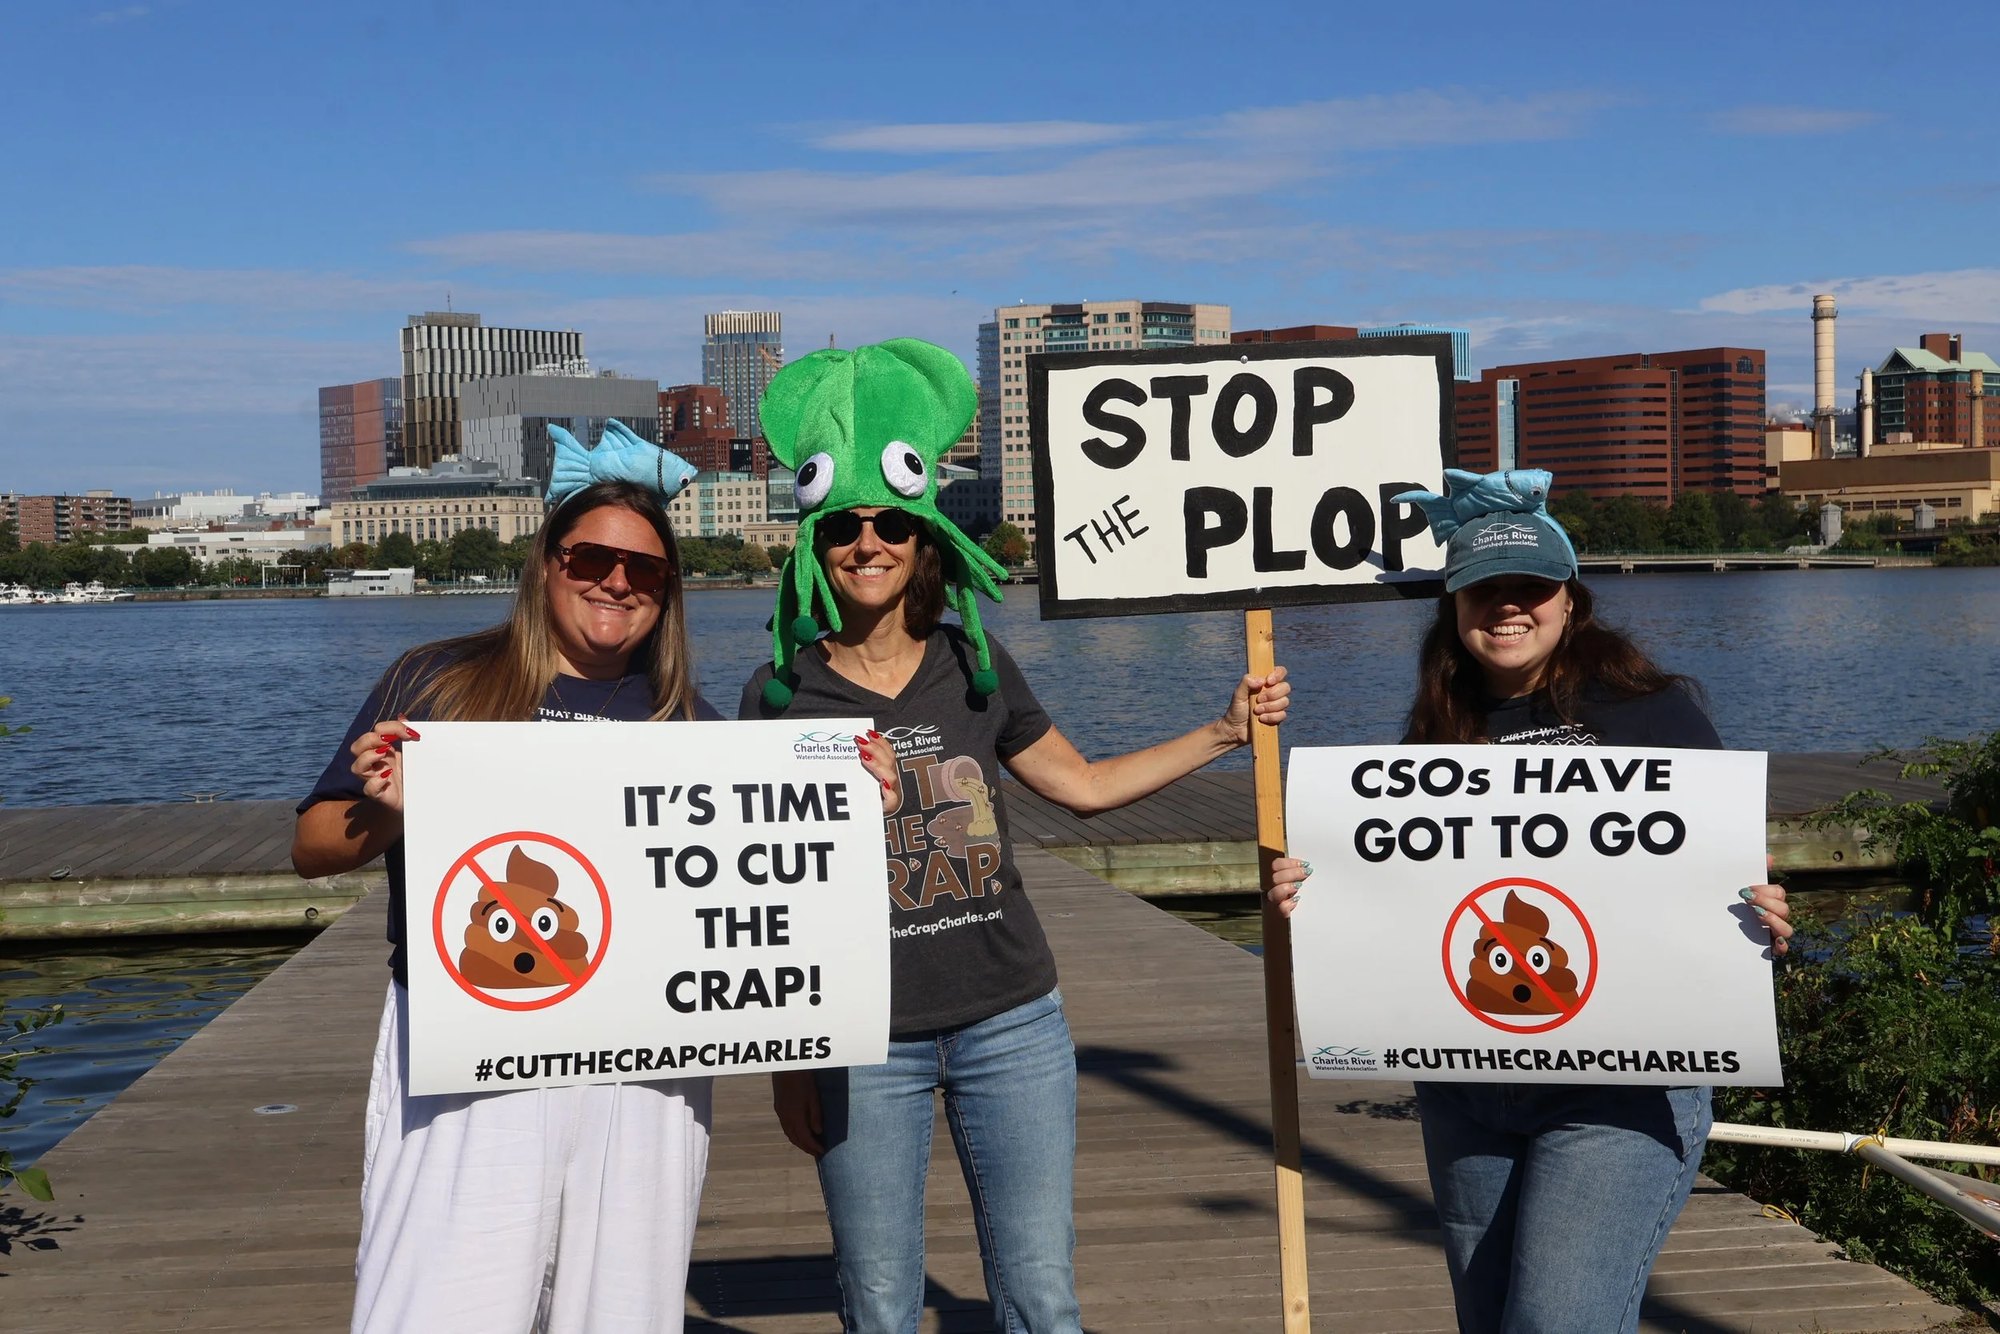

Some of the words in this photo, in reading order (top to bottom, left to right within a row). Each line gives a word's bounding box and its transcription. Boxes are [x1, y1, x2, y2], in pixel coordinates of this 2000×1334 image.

[1081, 366, 1355, 469] STOP
[1063, 494, 1150, 565] THE
[1183, 482, 1430, 578] PLOP
[1472, 532, 1509, 546] Charles
[1512, 531, 1538, 541] River
[1473, 541, 1503, 552] Watershed
[1504, 540, 1539, 548] Association
[538, 707, 571, 719] THAT
[793, 743, 831, 753] Charles
[833, 743, 858, 753] River
[892, 740, 913, 751] rles
[915, 735, 941, 747] River
[910, 745, 944, 756] Association
[1351, 757, 1491, 799] CSOs
[1513, 758, 1672, 794] HAVE
[624, 784, 716, 827] IT'S
[732, 783, 850, 823] TIME
[884, 814, 927, 855] HE
[1354, 816, 1473, 863] GOT
[1491, 814, 1569, 859] TO
[1589, 810, 1686, 857] GO
[645, 845, 718, 889] TO
[737, 841, 835, 886] CUT
[887, 843, 1001, 911] RAP
[695, 904, 790, 949] THE
[665, 965, 822, 1014] CRAP!
[474, 1036, 832, 1081] #CUTTHECRAPCHARLES
[1311, 1056, 1349, 1065] Charles
[1351, 1057, 1376, 1066] River
[1383, 1047, 1741, 1074] #CUTTHECRAPCHARLES
